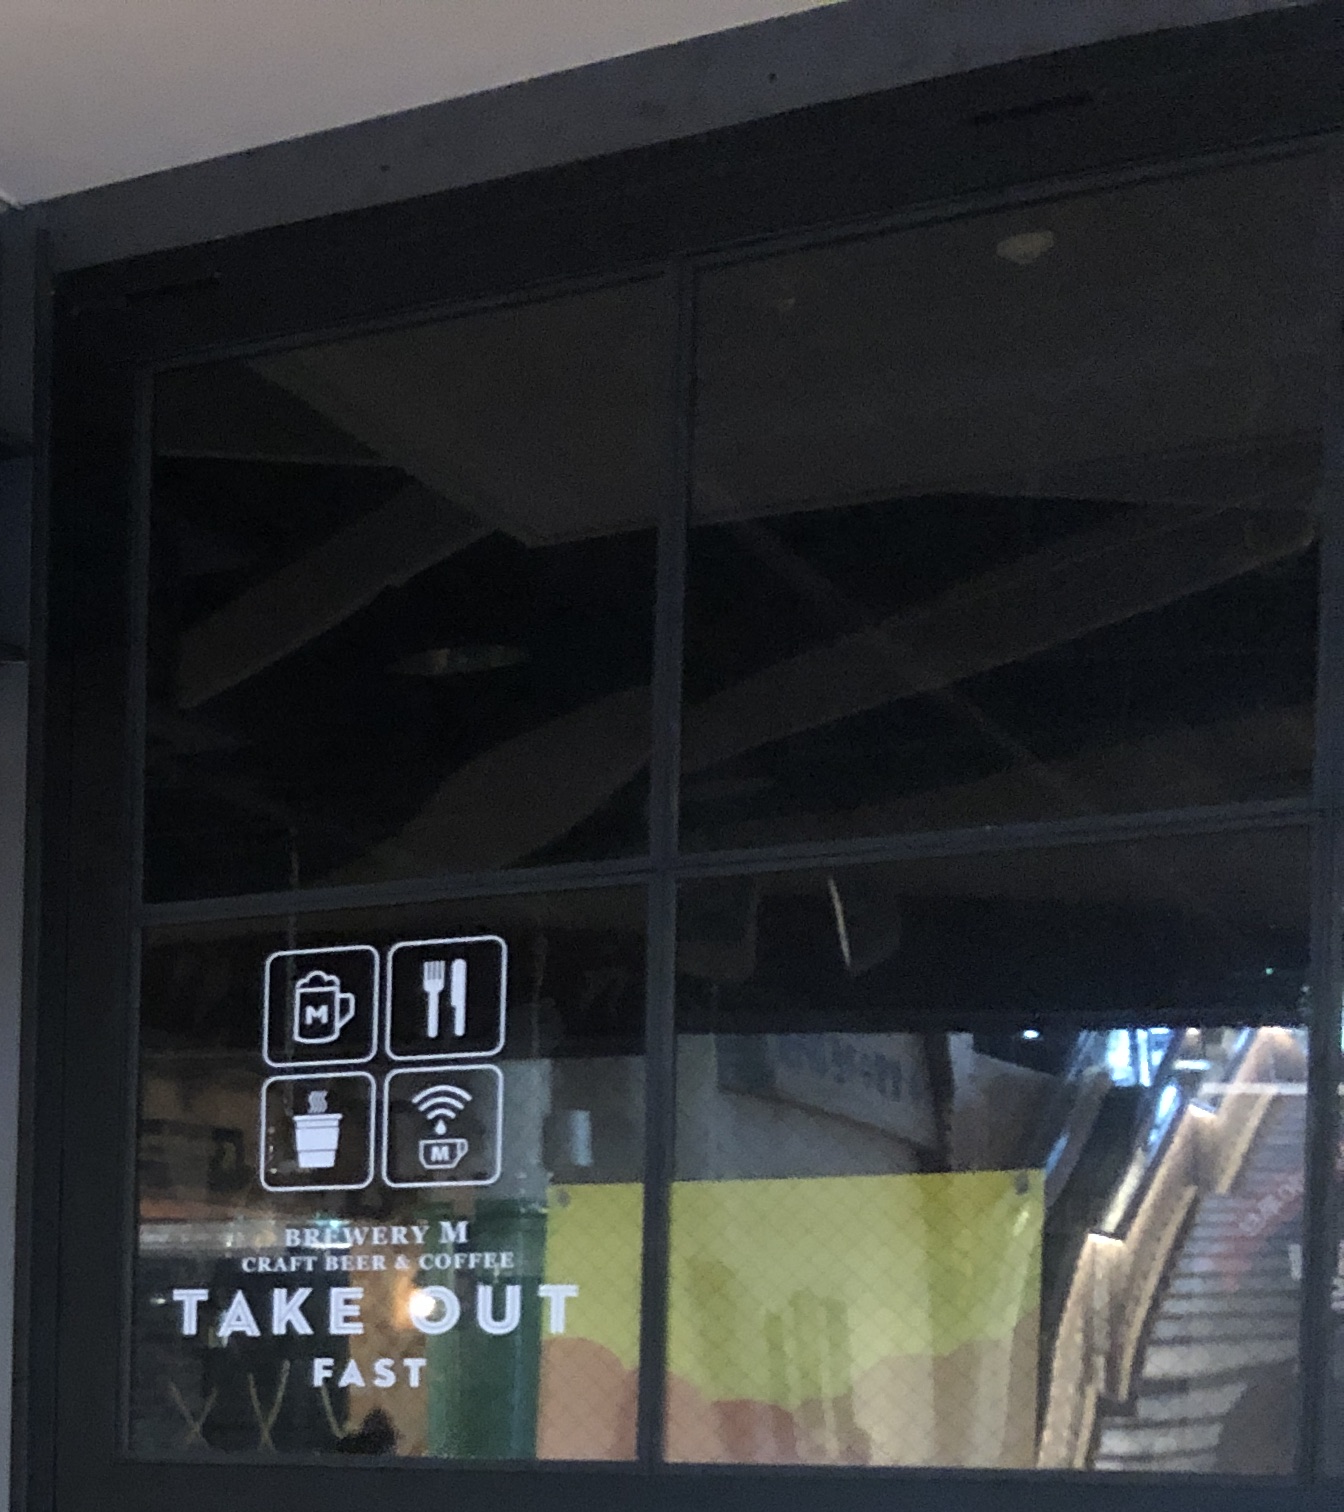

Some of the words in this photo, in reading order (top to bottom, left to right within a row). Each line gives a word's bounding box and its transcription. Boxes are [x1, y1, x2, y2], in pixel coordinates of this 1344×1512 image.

[285, 1226, 430, 1247] BREWERY
[439, 1221, 468, 1244] M
[242, 1256, 317, 1272] CRAFT
[326, 1254, 387, 1271] BEER
[394, 1254, 409, 1270] &
[419, 1252, 513, 1270] COFFEE
[172, 1287, 364, 1337] TAKE
[409, 1284, 579, 1336] OUT
[312, 1358, 427, 1388] FAST
